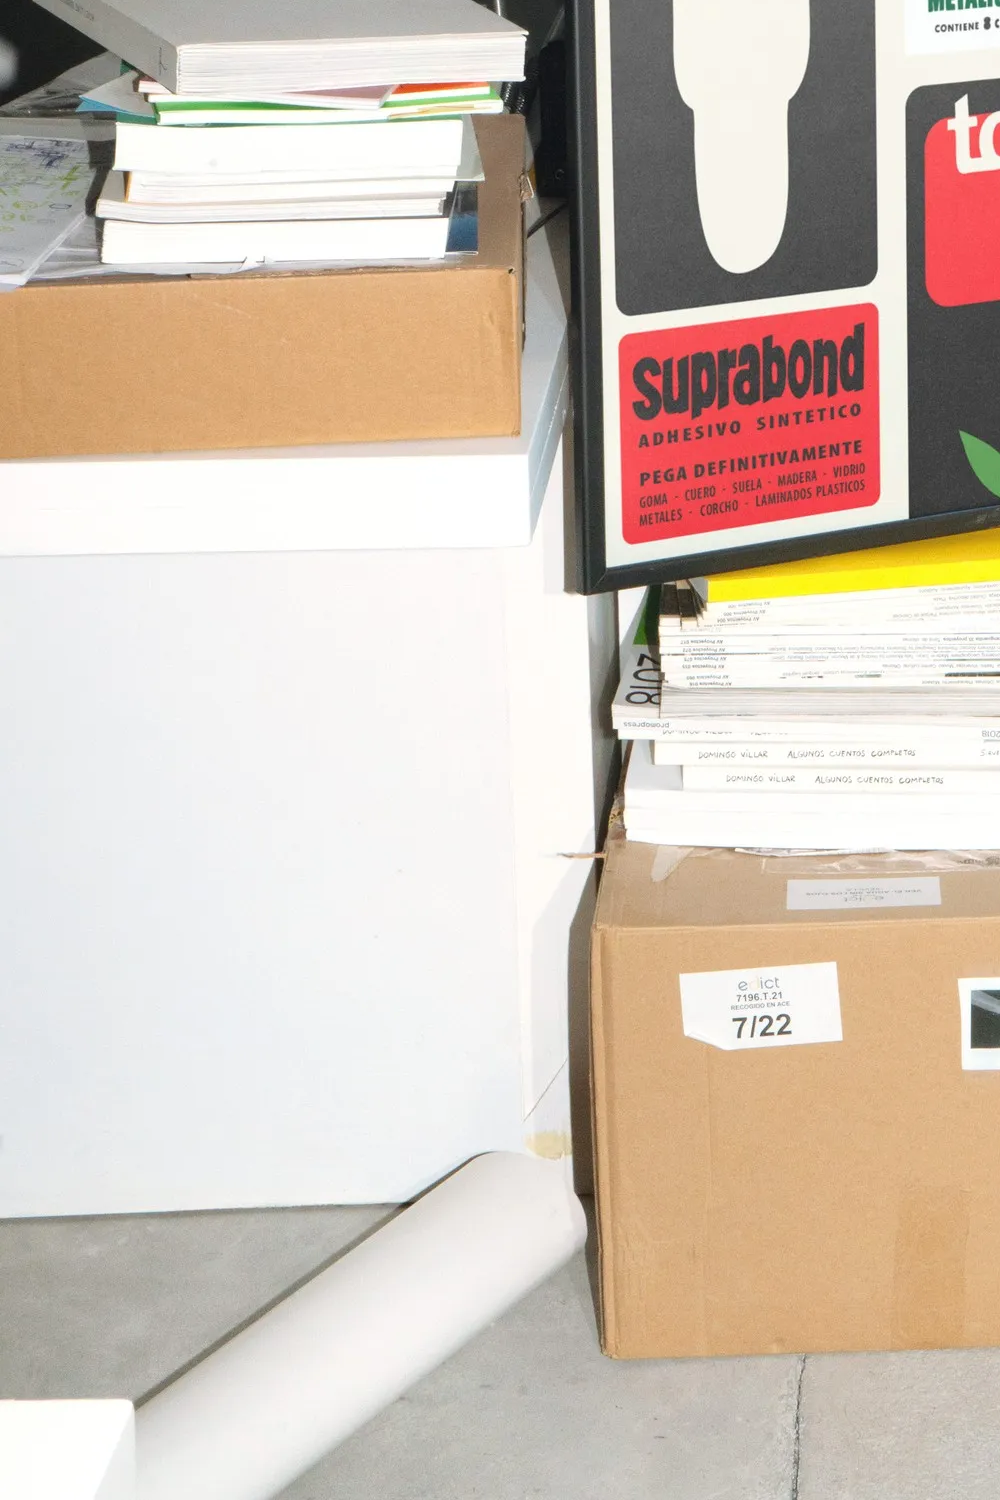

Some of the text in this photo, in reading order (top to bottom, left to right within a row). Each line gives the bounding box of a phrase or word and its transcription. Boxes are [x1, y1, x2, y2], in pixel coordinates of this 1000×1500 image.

[935, 22, 979, 33] CONTIENE
[983, 17, 991, 30] 8
[632, 322, 865, 420] Suprabond
[639, 403, 861, 448] ADHESIVO SINTETICO
[640, 440, 862, 487] PEGA DEFINITIVAMENTE
[640, 463, 865, 509] GOMA CUERO SUELA MADERA VIDRIO
[640, 479, 865, 527] METALES CORCHO LAMINADOS PLASTICOS
[623, 721, 670, 730] promopress
[982, 730, 1000, 738] 2018
[787, 750, 824, 758] ALGUNOS
[871, 749, 916, 757] COMPLETOS
[815, 775, 852, 783] ALGUNOS
[858, 776, 893, 784] CUENTOS
[736, 992, 783, 1002] 7196.T.21
[732, 1013, 792, 1039] 7/22
